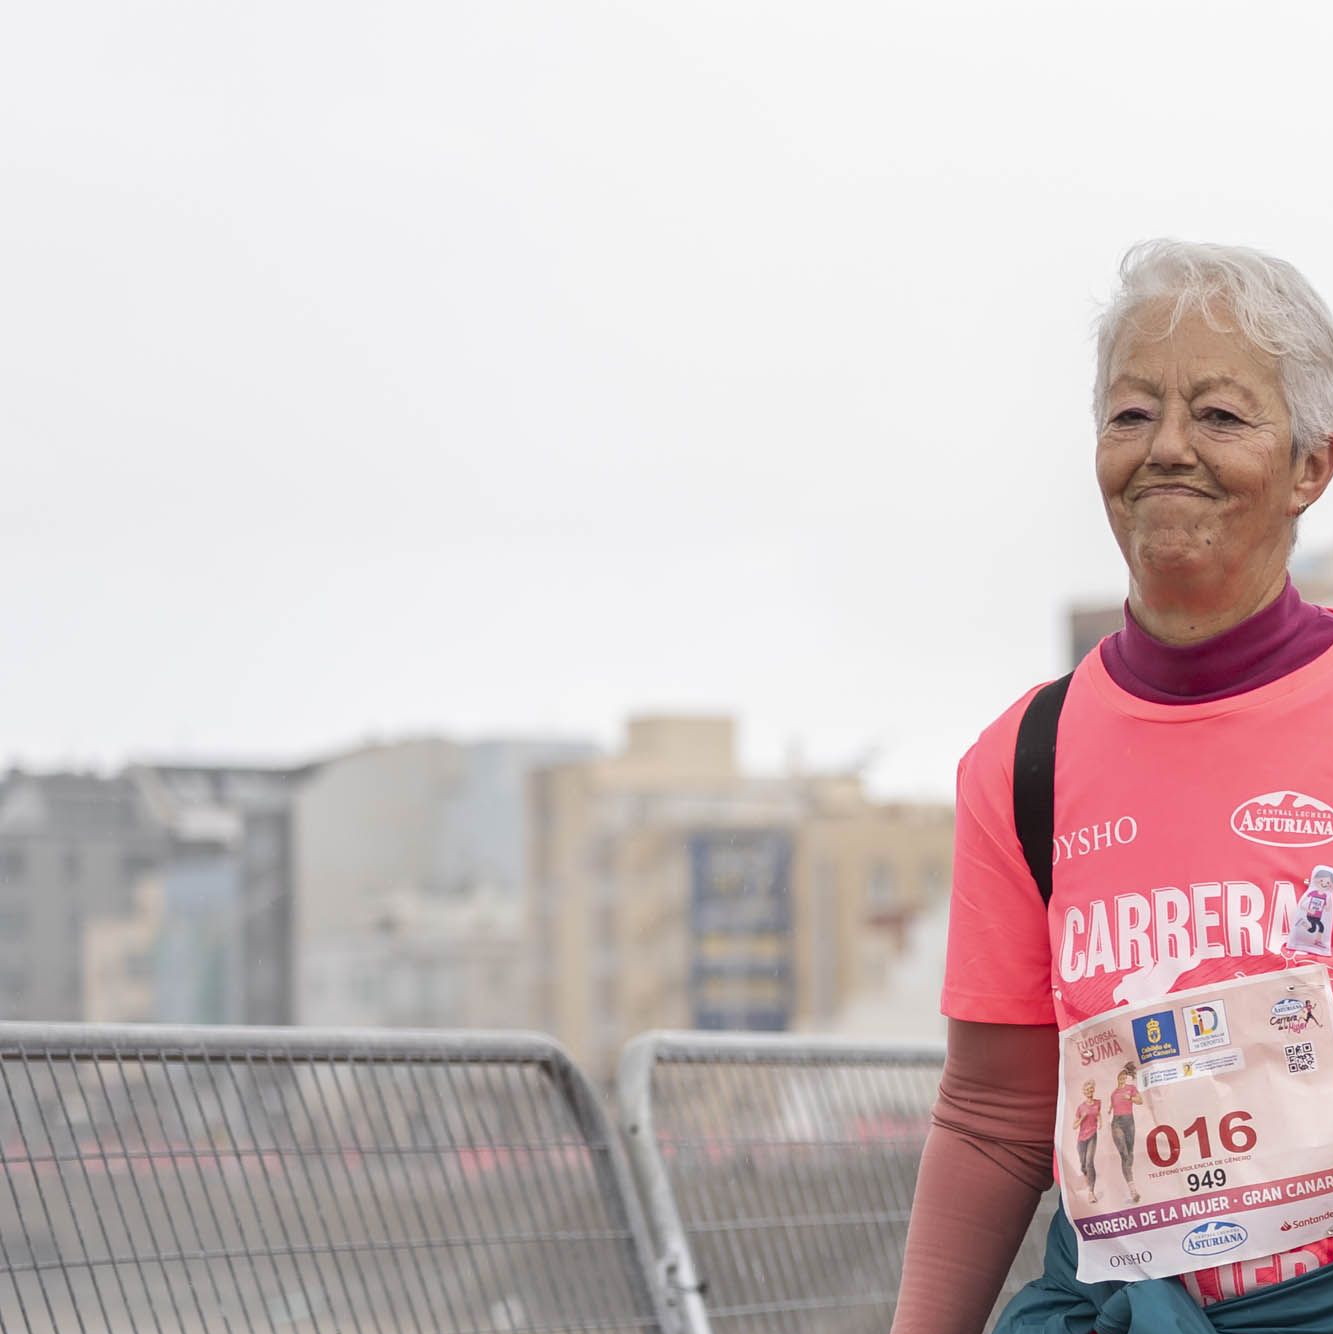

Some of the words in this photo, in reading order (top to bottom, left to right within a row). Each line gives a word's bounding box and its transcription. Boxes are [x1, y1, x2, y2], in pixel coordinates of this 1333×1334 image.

[1256, 809, 1292, 817] CENTRAL
[1081, 1040, 1123, 1066] SUMA
[1146, 1110, 1257, 1167] 016
[1179, 1161, 1214, 1173] VIOLENCIA
[1187, 1168, 1227, 1192] 949
[1083, 1217, 1137, 1237] CARRERA
[1140, 1210, 1158, 1226] DE
[1160, 1206, 1178, 1222] LA
[1181, 1196, 1230, 1218] MUJER
[1242, 1186, 1282, 1206] GRAN
[1188, 1232, 1243, 1252] ASTURIANA
[1109, 1250, 1153, 1268] OYSHO
